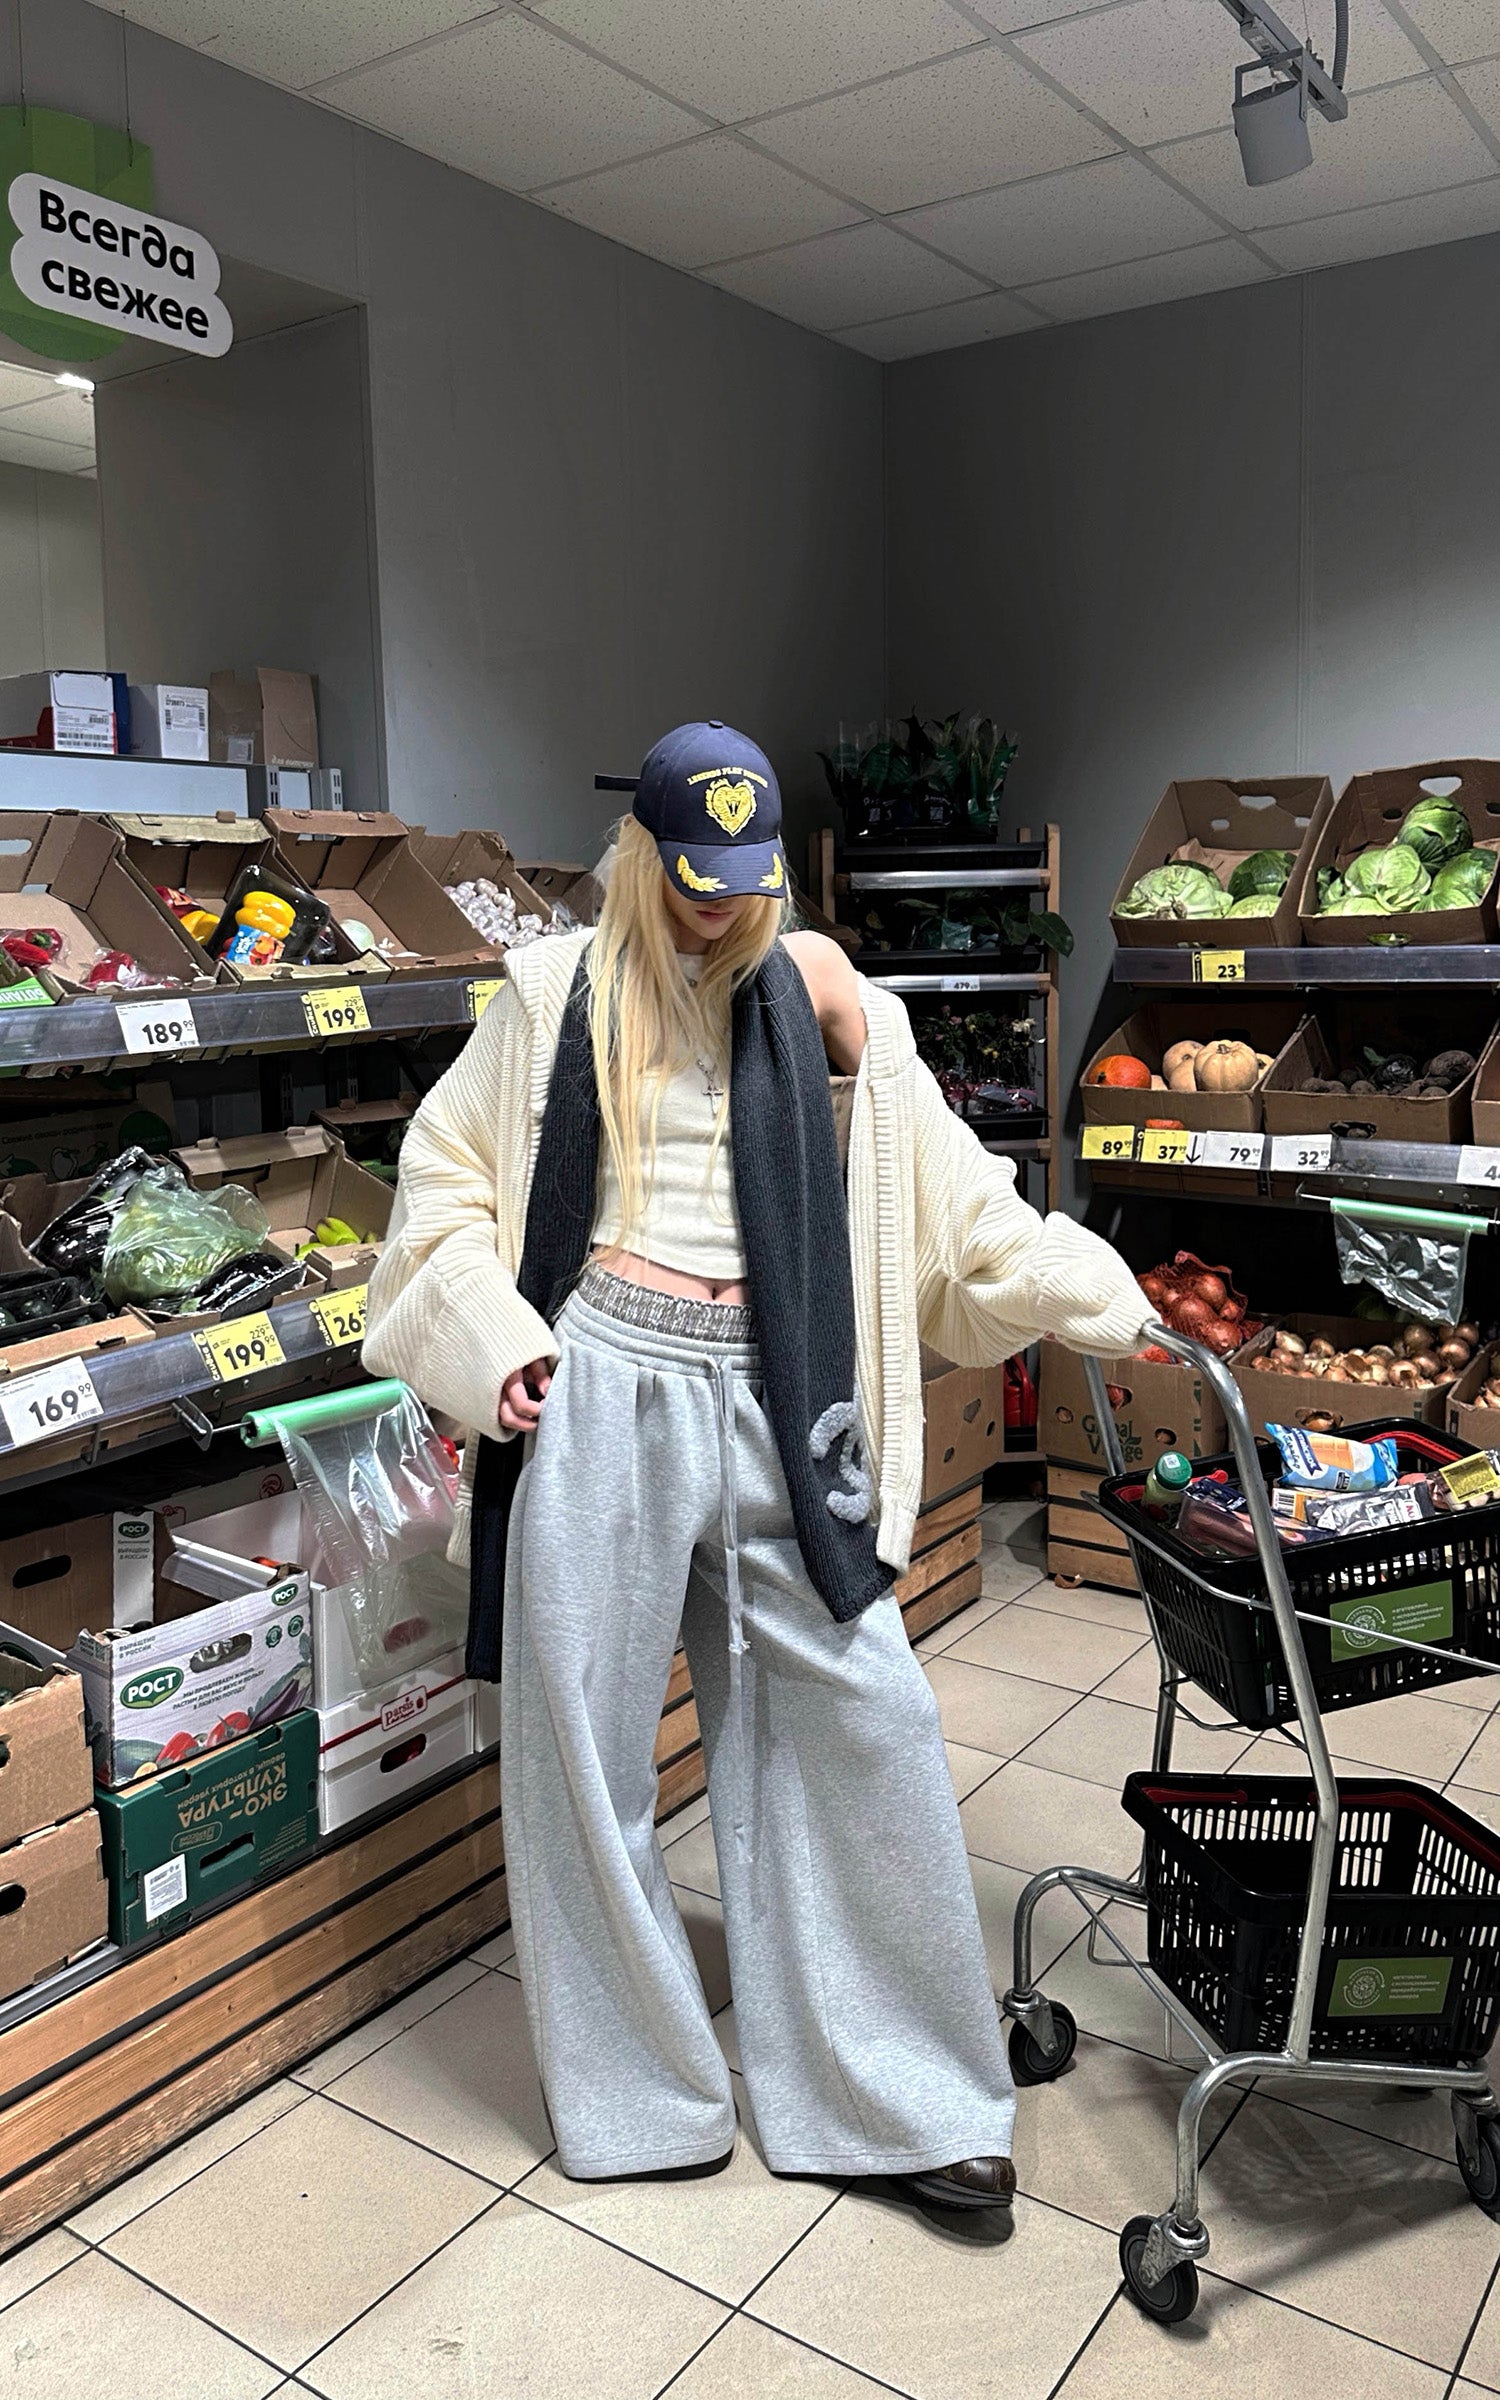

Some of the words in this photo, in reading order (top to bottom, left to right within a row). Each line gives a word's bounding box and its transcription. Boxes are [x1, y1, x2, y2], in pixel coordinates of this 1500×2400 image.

[39, 188, 195, 280] Всегда
[41, 260, 209, 338] свежее
[1218, 964, 1237, 978] 23
[322, 1007, 356, 1028] 199
[141, 1021, 183, 1045] 189
[183, 1020, 194, 1028] 99
[1102, 1140, 1123, 1155] 89
[1158, 1145, 1178, 1160] 37
[1230, 1147, 1251, 1161] 79
[1298, 1151, 1319, 1166] 32
[1484, 1165, 1500, 1180] 4
[249, 1327, 266, 1339] 229
[202, 1345, 221, 1381] Скидка
[223, 1339, 266, 1370] 199
[264, 1334, 276, 1344] 99
[28, 1389, 79, 1427] 169
[78, 1382, 92, 1395] 99
[1082, 1414, 1133, 1438] Gal
[122, 1525, 146, 1533] РОСТ
[274, 1586, 296, 1602] РОСТ
[127, 1672, 177, 1703] РОСТ
[211, 1770, 248, 1792] которых
[177, 1786, 210, 1809] уверен
[178, 1761, 286, 1828] КУЛЬТУРА
[229, 1782, 287, 1819] ЭКО-
